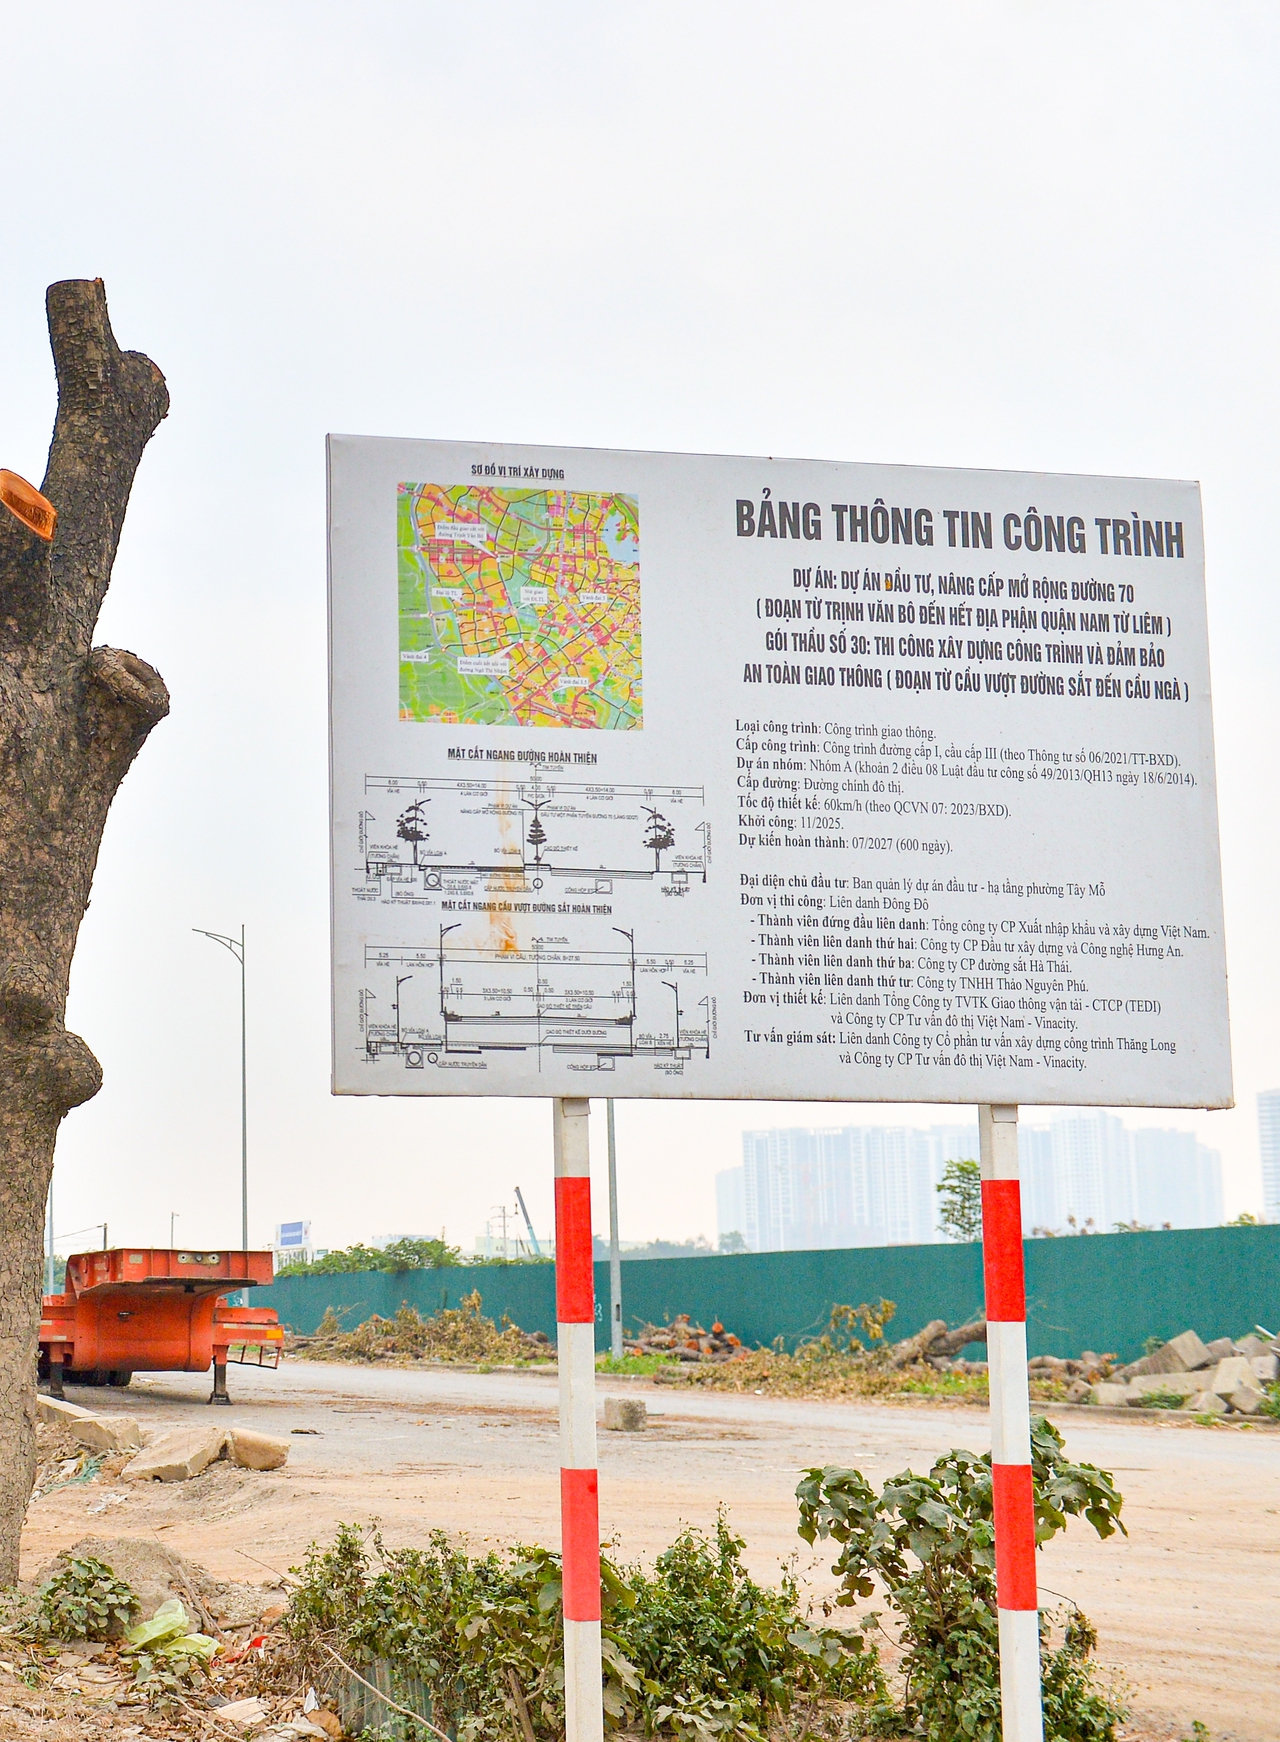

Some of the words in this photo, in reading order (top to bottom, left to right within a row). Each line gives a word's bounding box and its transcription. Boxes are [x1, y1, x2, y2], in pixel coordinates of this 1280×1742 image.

[471, 464, 482, 475] SƠ
[497, 465, 506, 478] VỊ
[523, 465, 539, 478] XÂY
[735, 487, 821, 540] BẢNG
[830, 497, 934, 546] THÔNG
[943, 511, 992, 549] TIN
[1002, 506, 1086, 553] CÔNG
[1094, 511, 1184, 558] TRÌNH
[792, 567, 811, 592] DỰ
[814, 567, 837, 589] ÁN:
[840, 569, 859, 594] DỰ
[862, 570, 880, 591] ÁN
[884, 571, 910, 592] ĐẦU
[914, 573, 934, 596] TƯ,
[938, 574, 974, 596] NÂNG
[978, 575, 1004, 597] CẤP
[1008, 577, 1028, 598] MỞ
[1032, 578, 1067, 603] RỘNG
[1070, 580, 1115, 602] ĐƯỜNG
[1118, 583, 1134, 603] 70
[764, 598, 801, 622] ĐOẠN
[804, 599, 822, 619] TỪ
[824, 600, 864, 625] TRỊNH
[867, 601, 894, 623] VĂN
[897, 603, 915, 624] BÔ
[918, 603, 945, 625] ĐẾN
[949, 605, 972, 626] HẾT
[975, 607, 998, 631] ĐỊA
[1001, 607, 1037, 633] PHẬN
[1040, 609, 1076, 635] QUẬN
[1079, 612, 1109, 632] NAM
[1112, 611, 1130, 633] TỪ
[1132, 612, 1163, 635] LIÊM
[765, 628, 787, 651] GÓI
[790, 629, 825, 653] THẦU
[829, 630, 846, 654] SỐ
[850, 635, 870, 655] 30:
[873, 635, 894, 656] THI
[898, 633, 934, 657] CÔNG
[937, 635, 963, 659] XÂY
[966, 638, 1002, 664] DỰNG
[1006, 638, 1041, 662] CÔNG
[1044, 640, 1083, 664] TRÌNH
[1086, 641, 1103, 665] VÀ
[1106, 642, 1136, 666] ĐẢM
[1139, 643, 1164, 668] BẢO
[743, 663, 762, 683] AN
[765, 663, 800, 684] TOÀN
[804, 665, 835, 686] GIAO
[838, 666, 882, 688] THÔNG
[895, 669, 931, 694] ĐOẠN
[934, 670, 952, 691] TỪ
[954, 670, 980, 692] CẦU
[984, 672, 1016, 698] VƯỢT
[1020, 673, 1064, 695] ĐƯỜNG
[1068, 675, 1092, 696] SẮT
[1095, 676, 1121, 698] ĐẾN
[1125, 677, 1150, 699] CẦU
[1154, 679, 1181, 700] NGÀ
[735, 718, 760, 735] Loại
[762, 719, 788, 736] công
[791, 721, 821, 734] trình:
[824, 722, 852, 738] Công
[854, 723, 878, 736] trình
[881, 724, 902, 740] giao
[905, 725, 936, 742] thông.
[447, 746, 466, 761] MẶT
[467, 745, 484, 760] CẮT
[486, 749, 515, 761] NGANG
[517, 748, 546, 761] ĐƯỜNG
[548, 750, 570, 762] HOÀN
[573, 751, 597, 765] THIỆN
[736, 772, 759, 791] Cấp
[762, 776, 800, 792] đường:
[803, 777, 839, 794] Đường
[841, 778, 869, 792] chính
[872, 779, 885, 792] đô
[887, 780, 904, 795] thị.
[736, 793, 757, 808] Tốc
[760, 795, 774, 811] độ
[777, 794, 801, 809] thiết
[804, 795, 820, 810] kế:
[823, 798, 862, 811] 60km/h
[864, 799, 890, 814] (theo
[893, 800, 928, 816] QCVN
[931, 801, 947, 814] 07:
[950, 802, 1011, 819] 2023/BXD).
[738, 813, 765, 827] Khởi
[768, 814, 796, 832] công:
[801, 816, 844, 829] 11/2025.
[738, 833, 756, 848] Dự
[758, 831, 781, 846] kiến
[784, 834, 811, 847] hoàn
[814, 835, 848, 848] thành:
[851, 836, 892, 850] 07/2027
[895, 838, 918, 853] (600
[921, 839, 952, 855] ngày).
[740, 892, 763, 905] Đơn
[766, 893, 776, 909] vị
[779, 894, 794, 906] thi
[797, 894, 826, 910] công:
[829, 895, 852, 908] Liên
[855, 895, 880, 908] danh
[882, 896, 910, 913] Đông
[913, 897, 928, 910] Đô
[838, 1050, 851, 1064] và
[853, 1051, 882, 1068] Công
[884, 1054, 894, 1068] ty
[897, 1052, 912, 1065] CP
[914, 1052, 930, 1065] Tư
[932, 1049, 951, 1065] vấn
[953, 1053, 966, 1066] đô
[969, 1053, 982, 1068] thị
[985, 1053, 1006, 1069] Việt
[1008, 1054, 1033, 1067] Nam
[1042, 1055, 1086, 1071] Vinacity.
